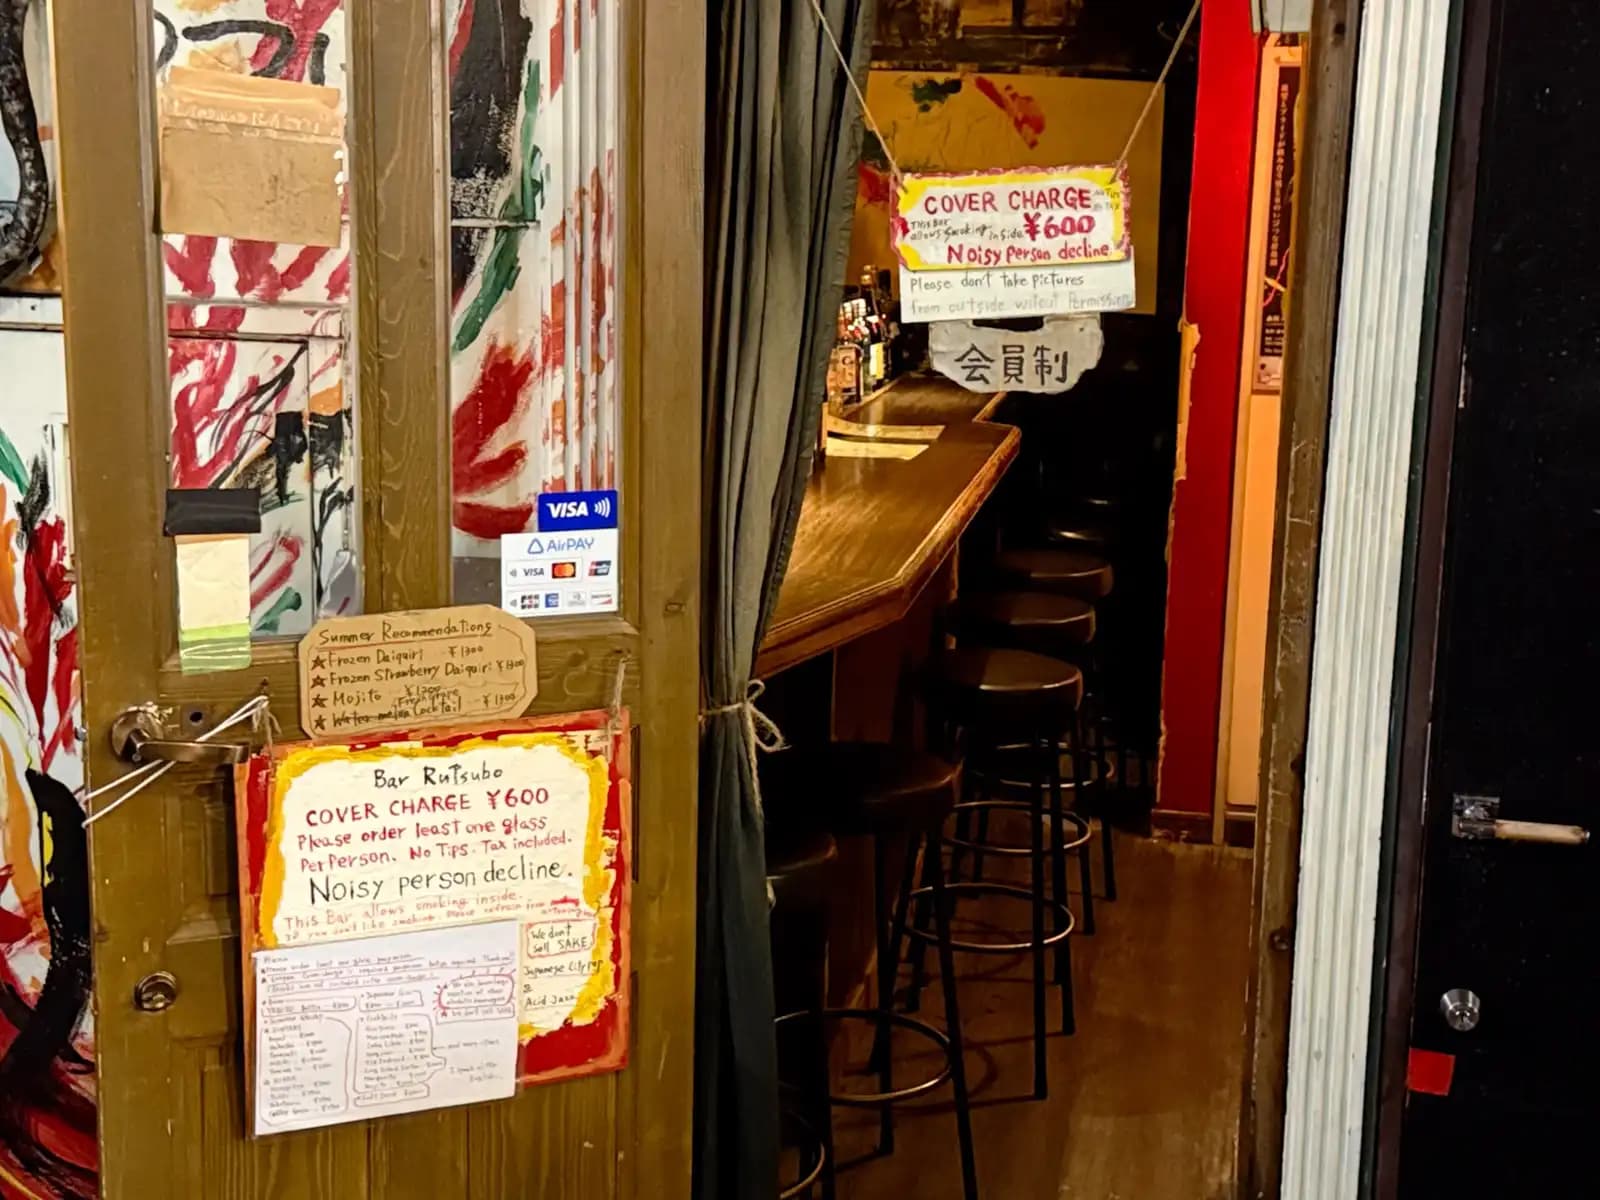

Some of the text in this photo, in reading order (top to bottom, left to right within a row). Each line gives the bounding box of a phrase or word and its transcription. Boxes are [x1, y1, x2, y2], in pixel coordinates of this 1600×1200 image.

[924, 186, 1092, 215] COVER CHARGE
[1023, 212, 1096, 241] ¥600
[947, 244, 1001, 265] Noisy
[910, 275, 951, 293] Please
[1000, 273, 1029, 288] take
[948, 295, 1008, 314] outside
[953, 343, 1068, 386] 会員制
[546, 501, 589, 518] VISA
[546, 537, 594, 553] AirPAY
[523, 567, 545, 577] VISA
[319, 617, 492, 645] Summer Recommendations
[328, 650, 371, 667] Frozen
[376, 648, 423, 664] Daiquiri
[329, 671, 371, 685] Frozen
[374, 664, 440, 681] Strawberry
[444, 662, 492, 678] Daiquiri
[333, 687, 382, 706] Mojito
[374, 767, 411, 789] Bar
[306, 787, 550, 827] COVER CHARGE ¥600
[297, 814, 547, 852] Please order least one glass
[409, 845, 431, 861] No
[483, 839, 507, 851] Tax
[513, 831, 573, 850] included.
[309, 855, 573, 905] Noisy person decline.
[284, 914, 319, 929] This
[326, 908, 352, 925] Bar
[363, 902, 405, 919] allows
[415, 895, 469, 911] smoking
[558, 936, 588, 951] SAKE
